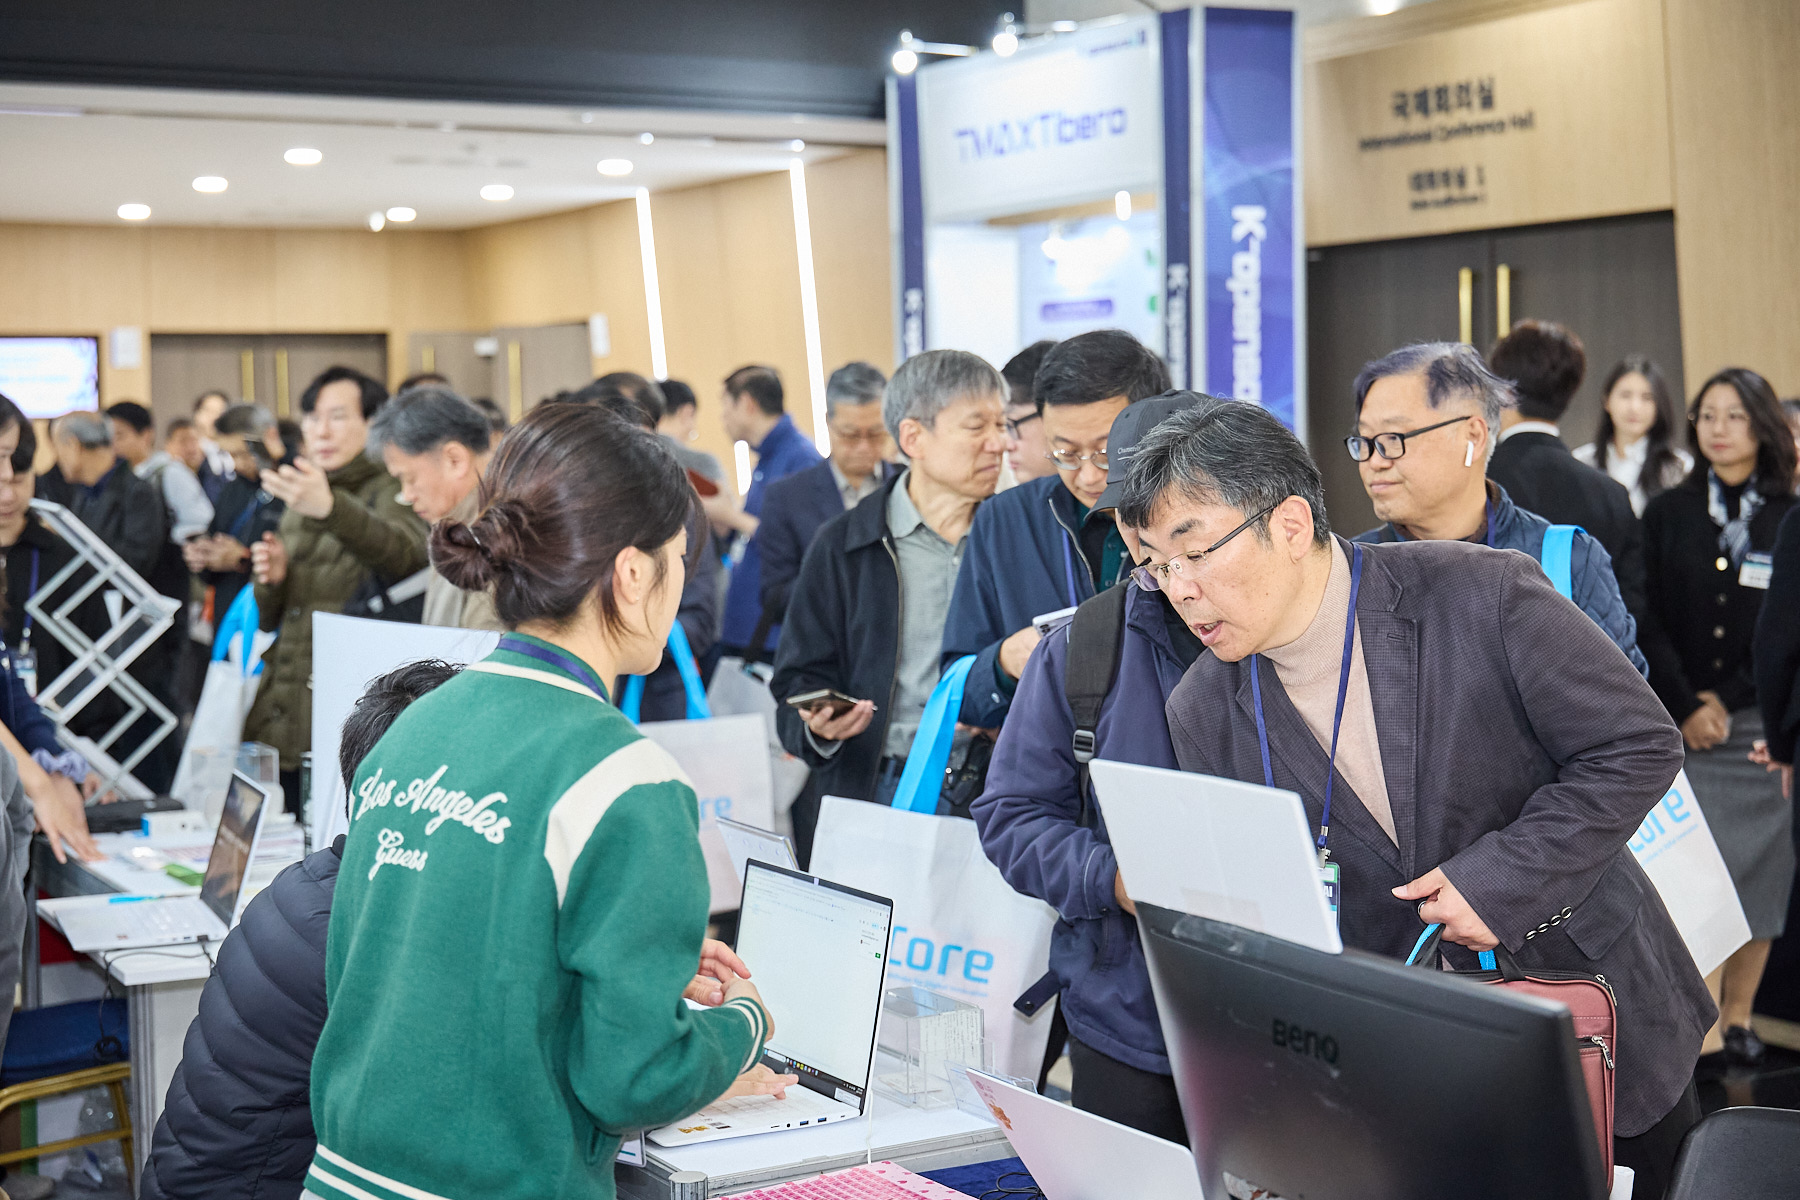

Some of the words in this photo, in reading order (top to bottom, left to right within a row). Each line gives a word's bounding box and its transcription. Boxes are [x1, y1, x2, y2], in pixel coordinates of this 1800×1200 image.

[355, 767, 397, 821] Los
[394, 764, 511, 844] Angeles
[368, 828, 428, 881] Guess
[1273, 1018, 1339, 1064] BenQ
